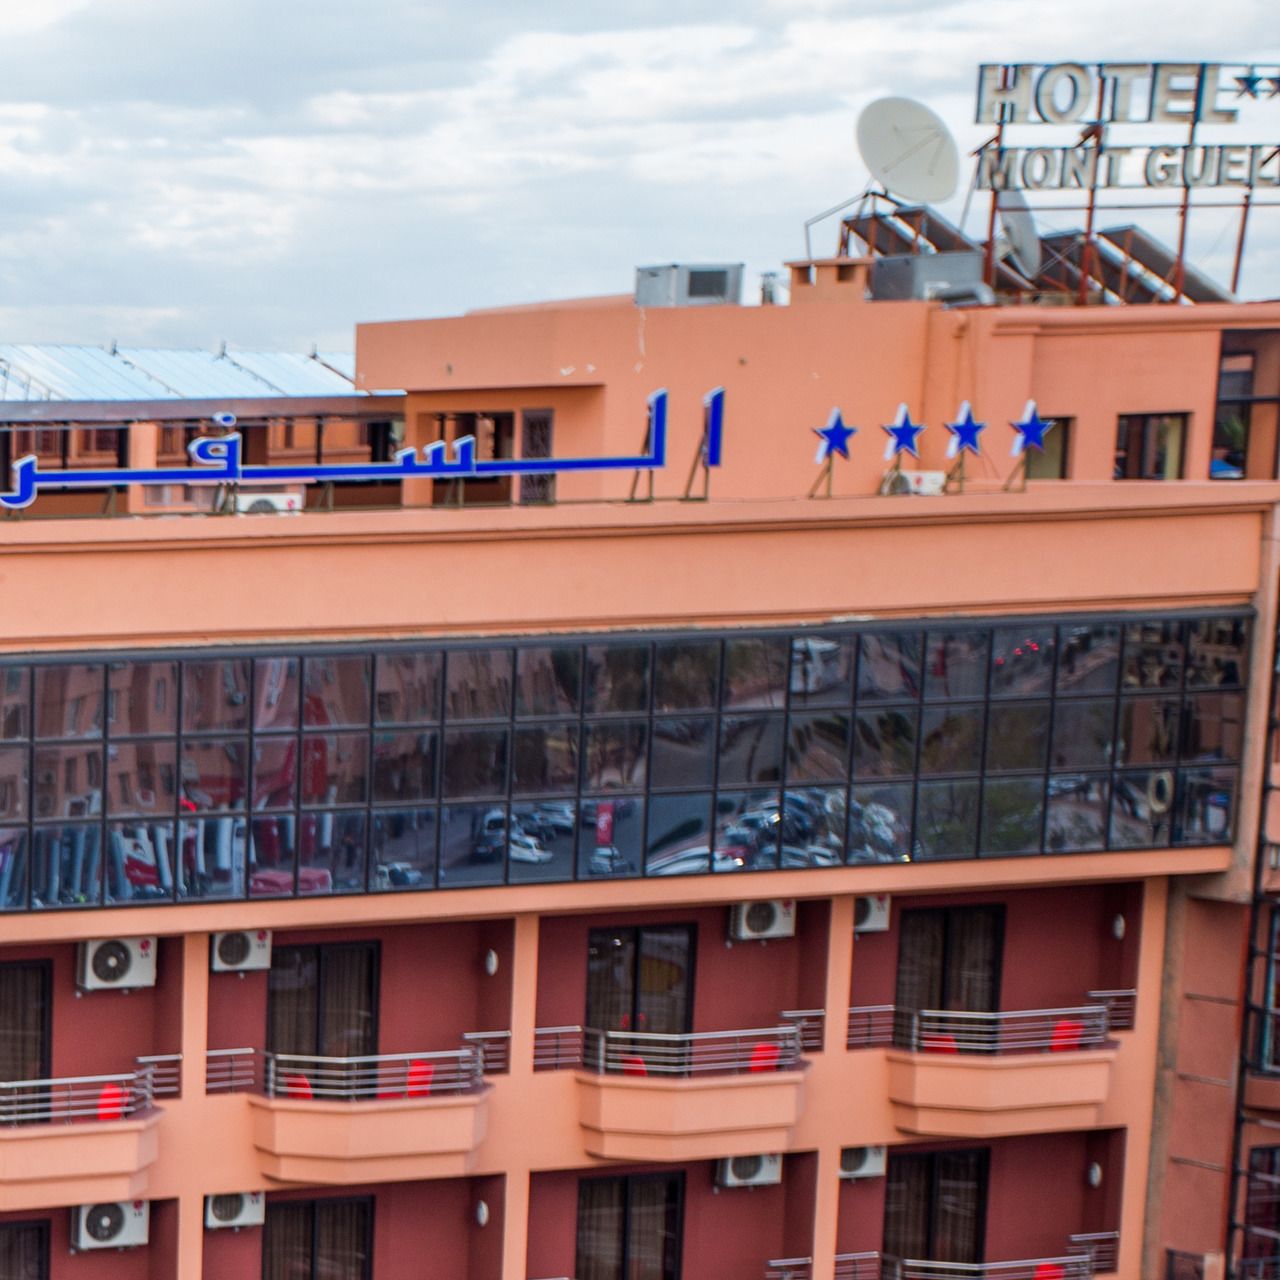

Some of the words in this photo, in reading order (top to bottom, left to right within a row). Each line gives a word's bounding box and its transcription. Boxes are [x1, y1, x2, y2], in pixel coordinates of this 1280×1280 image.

[974, 62, 1240, 124] HOTEL
[975, 146, 1133, 190] MONT
[1144, 144, 1280, 188] GUEL
